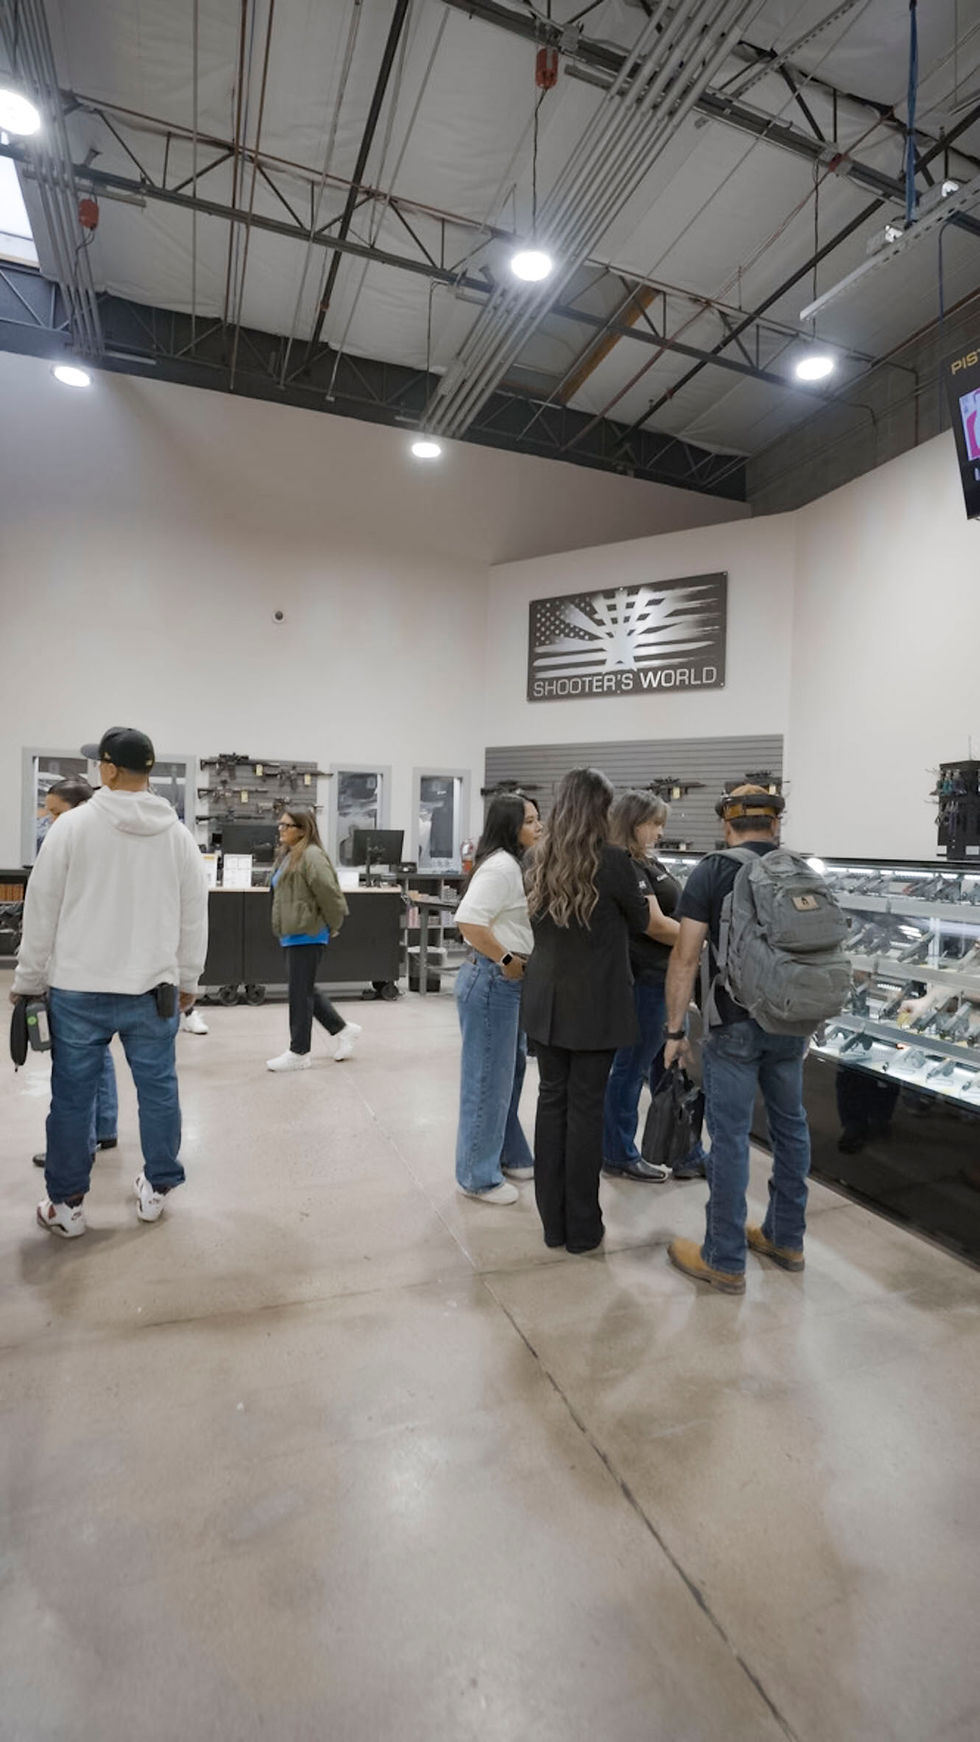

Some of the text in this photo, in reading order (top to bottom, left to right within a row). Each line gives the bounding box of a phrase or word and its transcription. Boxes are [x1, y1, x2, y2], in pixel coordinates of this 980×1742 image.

[951, 348, 980, 375] PIS
[533, 666, 717, 697] SHOOTER'S WORLD
